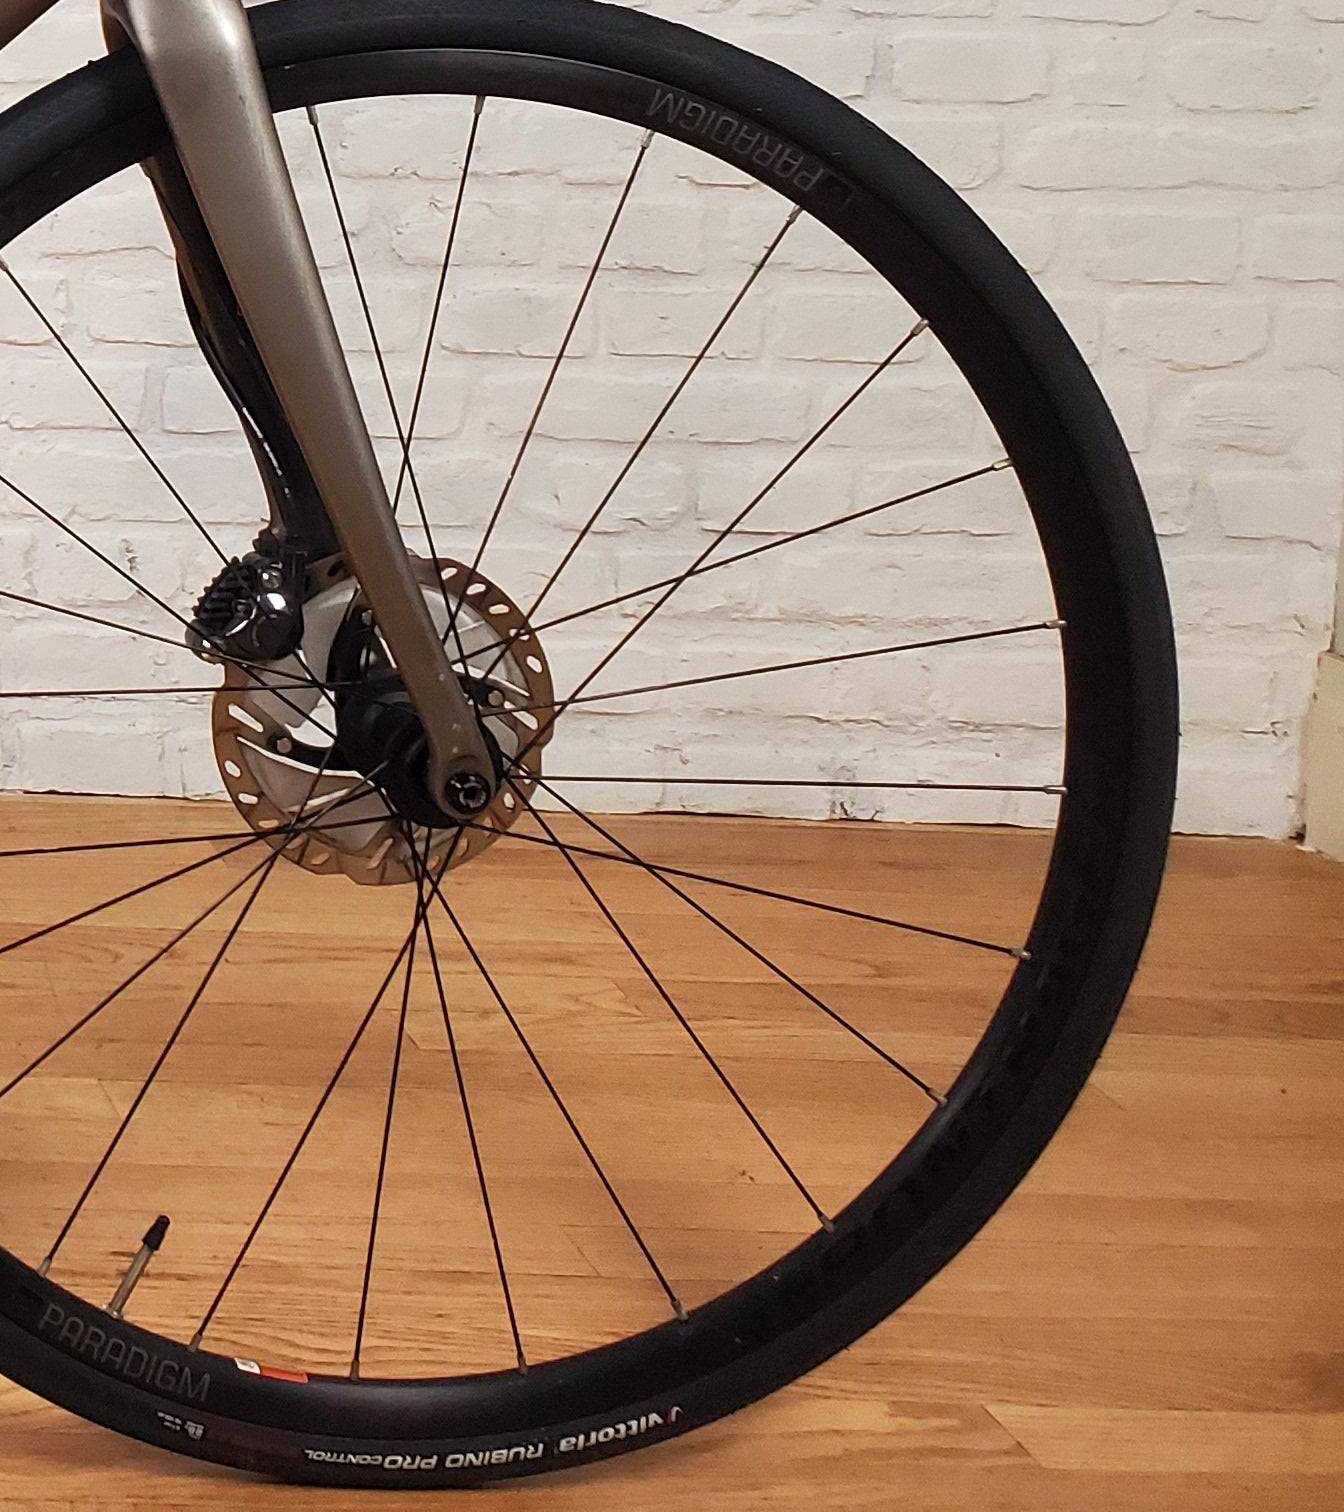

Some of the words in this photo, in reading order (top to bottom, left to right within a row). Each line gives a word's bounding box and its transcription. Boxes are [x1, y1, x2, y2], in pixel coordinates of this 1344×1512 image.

[644, 87, 827, 193] PARADIGM
[38, 1303, 212, 1403] PARADIGM
[445, 1443, 545, 1470] RUBINO
